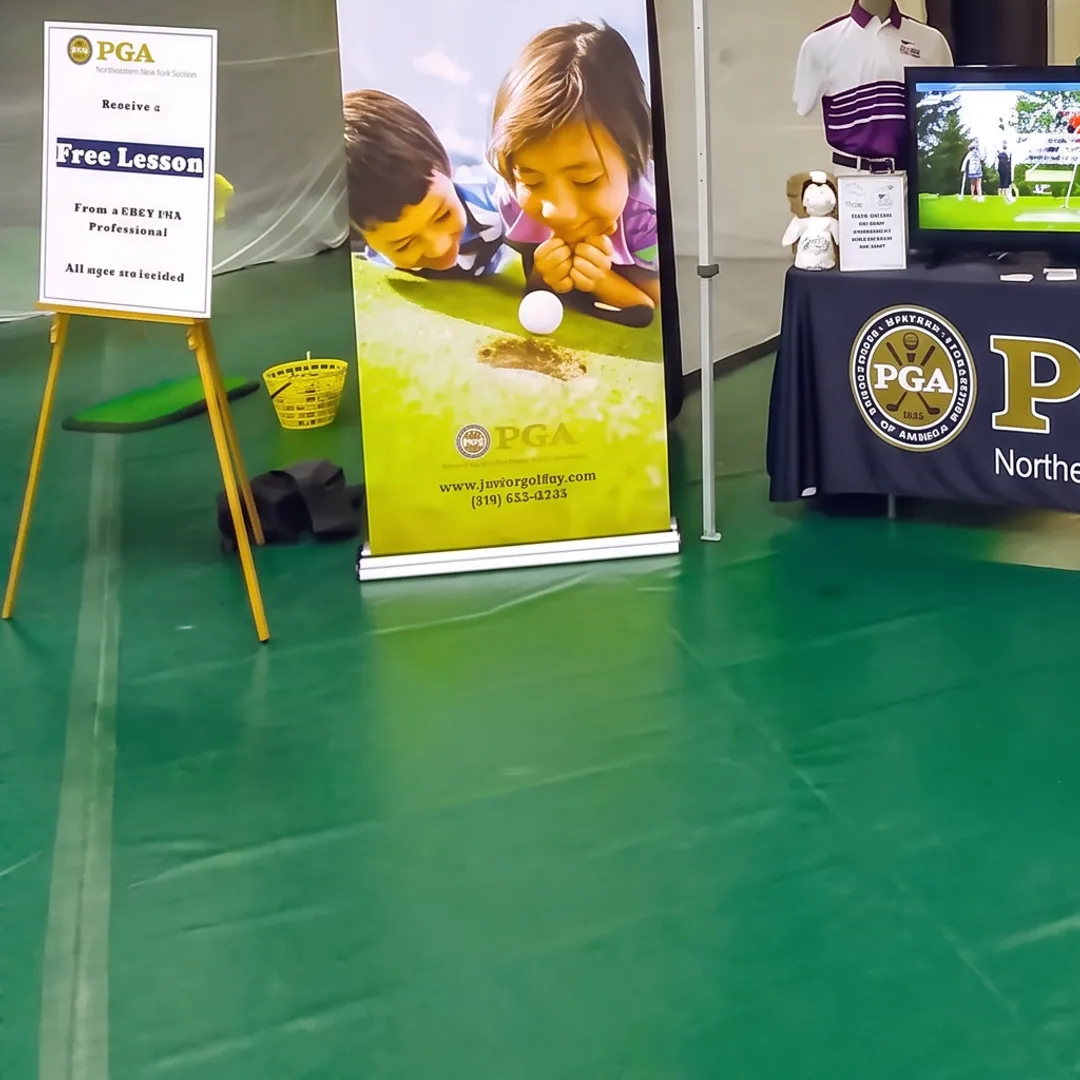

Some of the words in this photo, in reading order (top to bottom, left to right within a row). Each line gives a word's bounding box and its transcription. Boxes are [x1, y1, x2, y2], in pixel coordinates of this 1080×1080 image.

[96, 41, 156, 63] PGA
[56, 142, 111, 167] Free
[116, 146, 204, 174] Lesson
[74, 203, 107, 215] From
[88, 222, 168, 237] Professional
[65, 263, 84, 274] All
[872, 363, 953, 394] PGA
[494, 422, 579, 451] PGA
